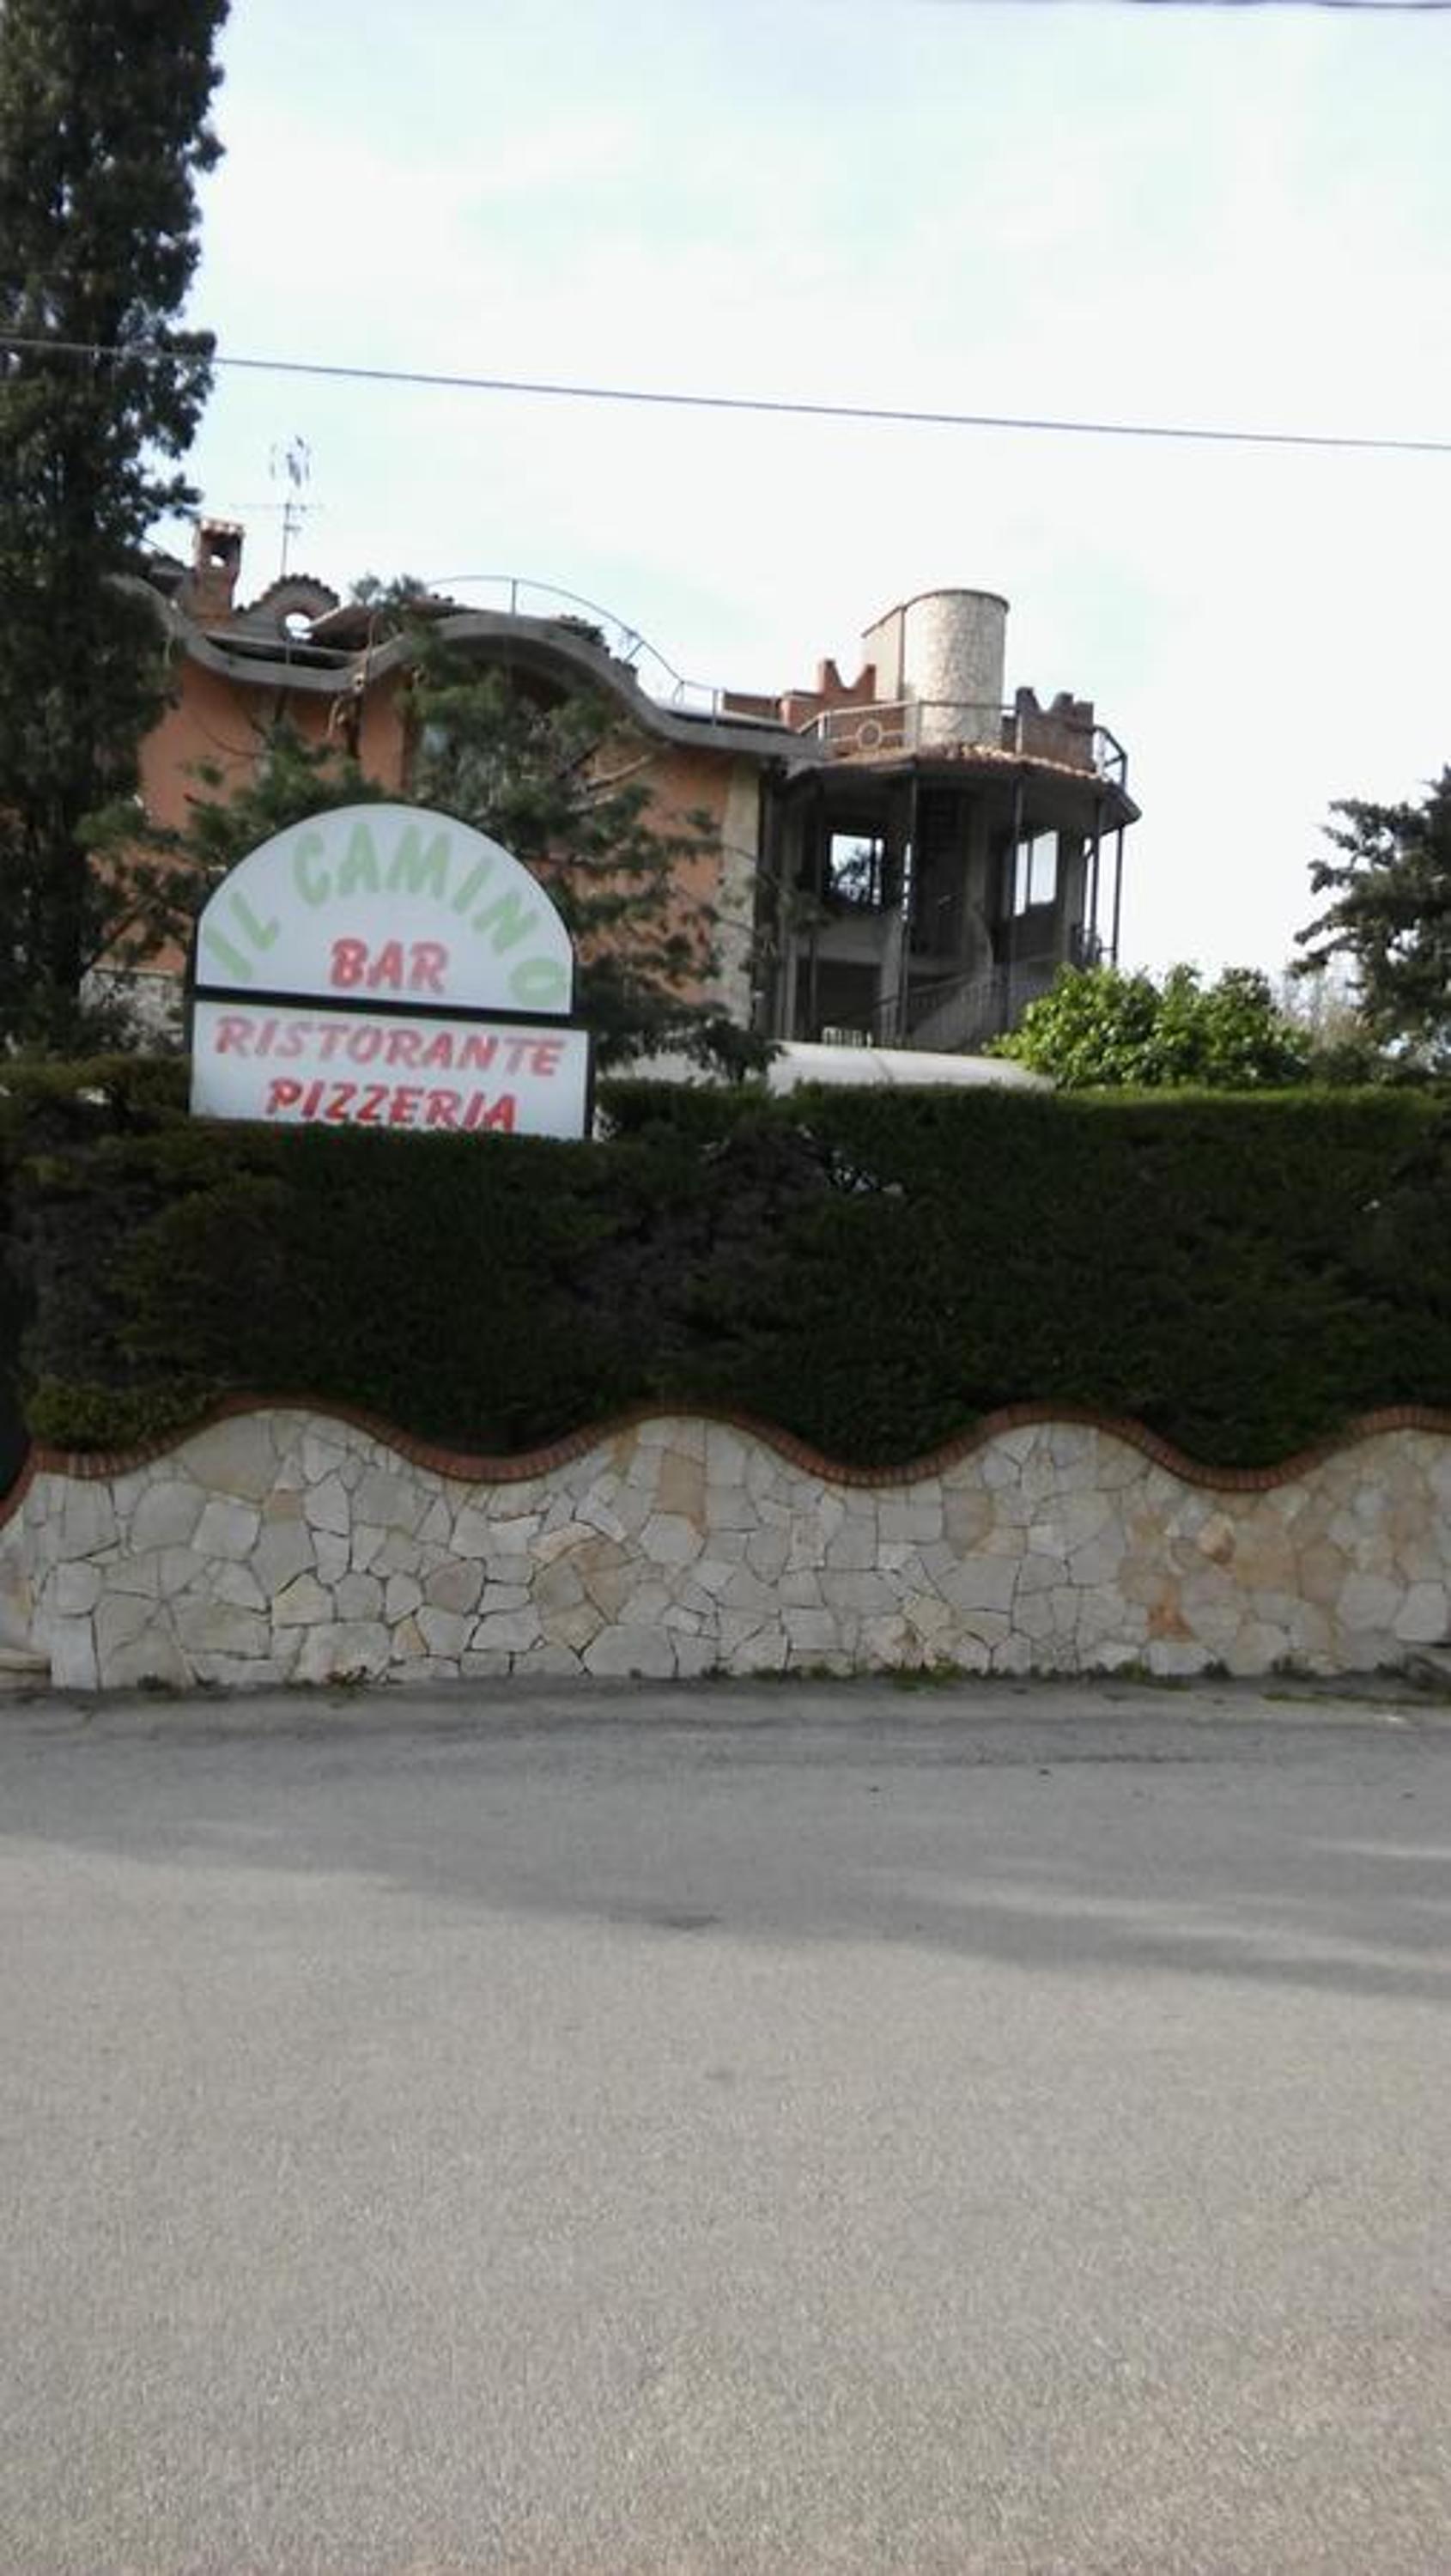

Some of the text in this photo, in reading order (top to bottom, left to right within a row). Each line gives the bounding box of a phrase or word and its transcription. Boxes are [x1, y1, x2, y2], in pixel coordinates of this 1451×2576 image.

[203, 821, 568, 1007] IL CAMINO
[328, 937, 451, 994] BAR
[214, 1014, 568, 1077] RISTORANTE
[265, 1078, 518, 1133] PIZZERIA
